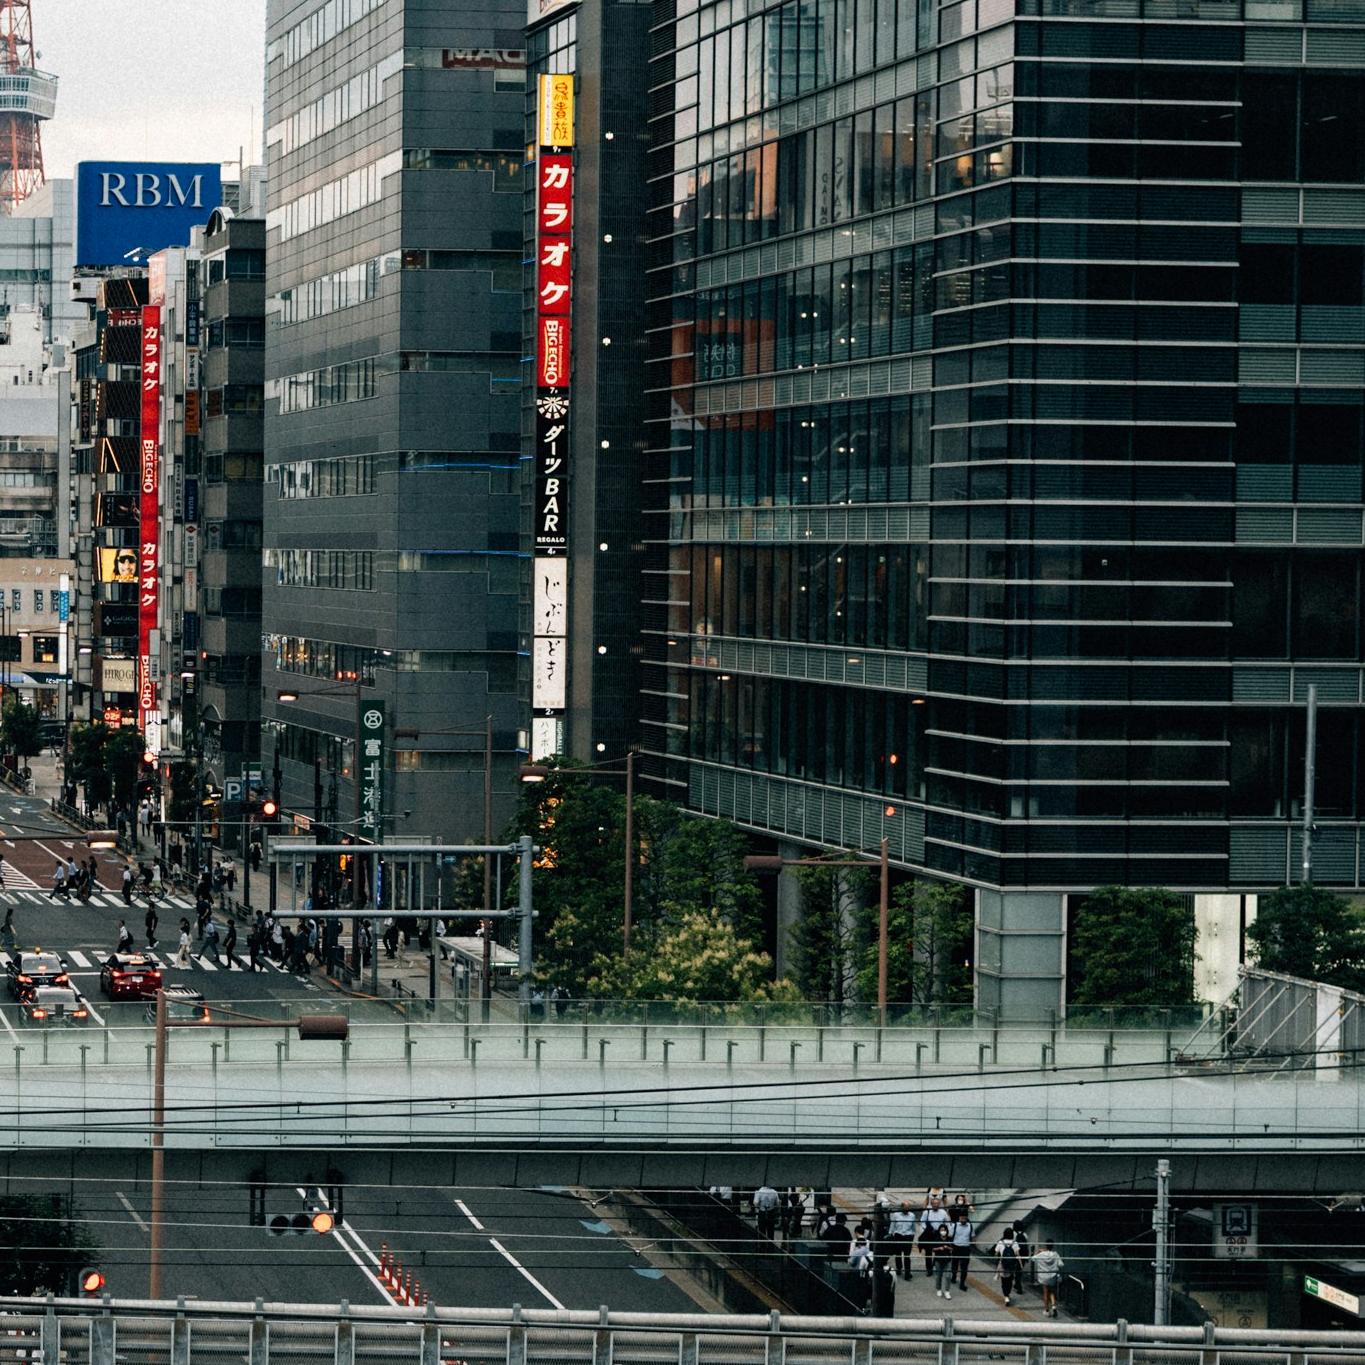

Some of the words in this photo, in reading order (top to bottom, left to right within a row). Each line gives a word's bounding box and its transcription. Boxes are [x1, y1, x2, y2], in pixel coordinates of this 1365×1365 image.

[99, 172, 204, 207] RBM
[541, 164, 569, 305] カラオケ
[545, 320, 558, 346] BIG
[143, 326, 158, 390] カラオケ
[545, 348, 558, 384] ECHO
[144, 439, 155, 461] BIG
[143, 461, 154, 493] ECHO
[141, 543, 156, 606] カラオケ
[227, 783, 238, 800] P
